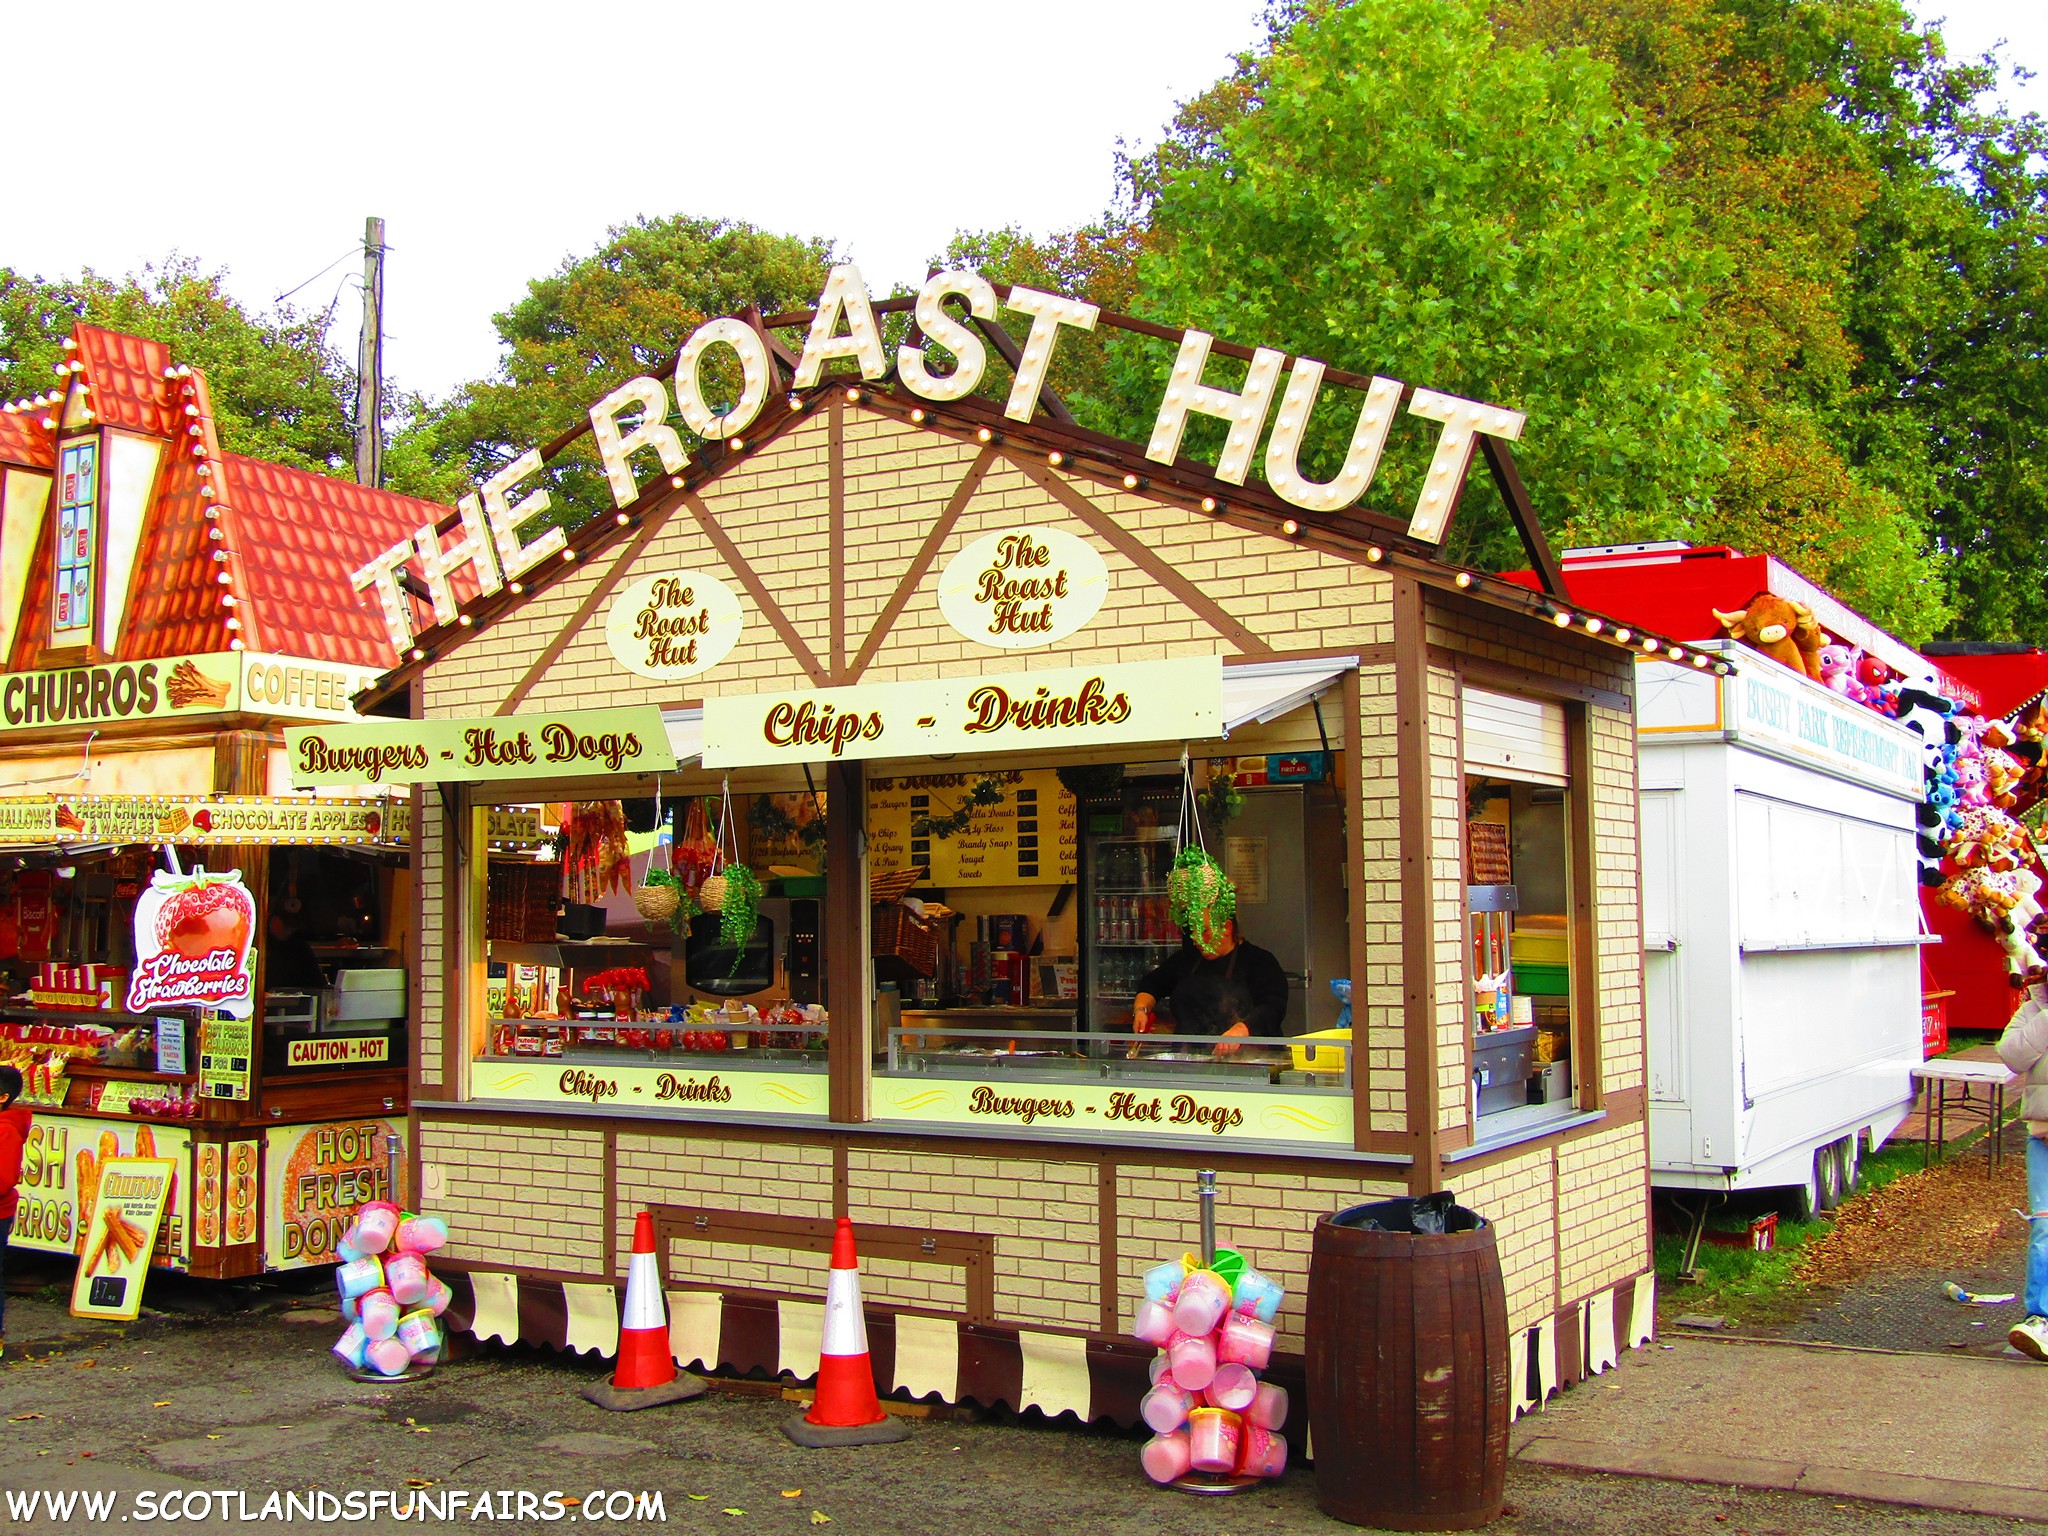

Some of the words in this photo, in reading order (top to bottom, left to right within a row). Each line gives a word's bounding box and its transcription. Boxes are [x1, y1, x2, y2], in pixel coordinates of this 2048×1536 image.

[350, 448, 567, 655] THE
[588, 264, 1100, 510] ROAST
[1144, 327, 1526, 545] HUT
[996, 533, 1050, 570] The
[649, 577, 695, 610] The
[974, 568, 1069, 604] Roast
[634, 608, 711, 640] Roast
[986, 600, 1053, 635] Hut
[644, 637, 700, 668] Hut
[4, 662, 159, 726] CHURROS
[246, 661, 347, 712] COFFEE
[763, 701, 884, 757] Chips
[963, 676, 1132, 735] Drinks
[1746, 676, 1791, 734] BUSHY
[1797, 699, 1829, 749] PARK
[299, 734, 429, 783] Burgers
[464, 727, 537, 767] Hot
[541, 722, 644, 772] Dogs
[75, 801, 112, 819] FRESH
[114, 802, 171, 820] CHURROS
[100, 818, 154, 835] WAFFLES
[209, 810, 306, 832] CHOCOLATE
[309, 809, 368, 831] APPLES
[392, 811, 411, 831] HO
[487, 815, 537, 837] OLATE
[1058, 804, 1077, 815] Coff
[878, 828, 898, 840] Chips
[1059, 865, 1077, 876] Wat
[144, 947, 237, 979] Chocolate
[134, 973, 245, 1004] Strawberries
[293, 1042, 349, 1062] CAUTION
[359, 1039, 385, 1059] HOT
[518, 1036, 539, 1045] nutella
[559, 1068, 619, 1103] Chips
[656, 1073, 733, 1103] Drinks
[968, 1086, 1076, 1124] Burgers
[1104, 1091, 1162, 1122] Hot
[1168, 1094, 1244, 1135] Dogs
[316, 1126, 377, 1166] HOT
[104, 1171, 163, 1200] Churros
[202, 1145, 214, 1245] DONUTS
[235, 1142, 248, 1242] DONUTS
[298, 1167, 389, 1212] FRESH
[9, 1196, 72, 1243] RROS
